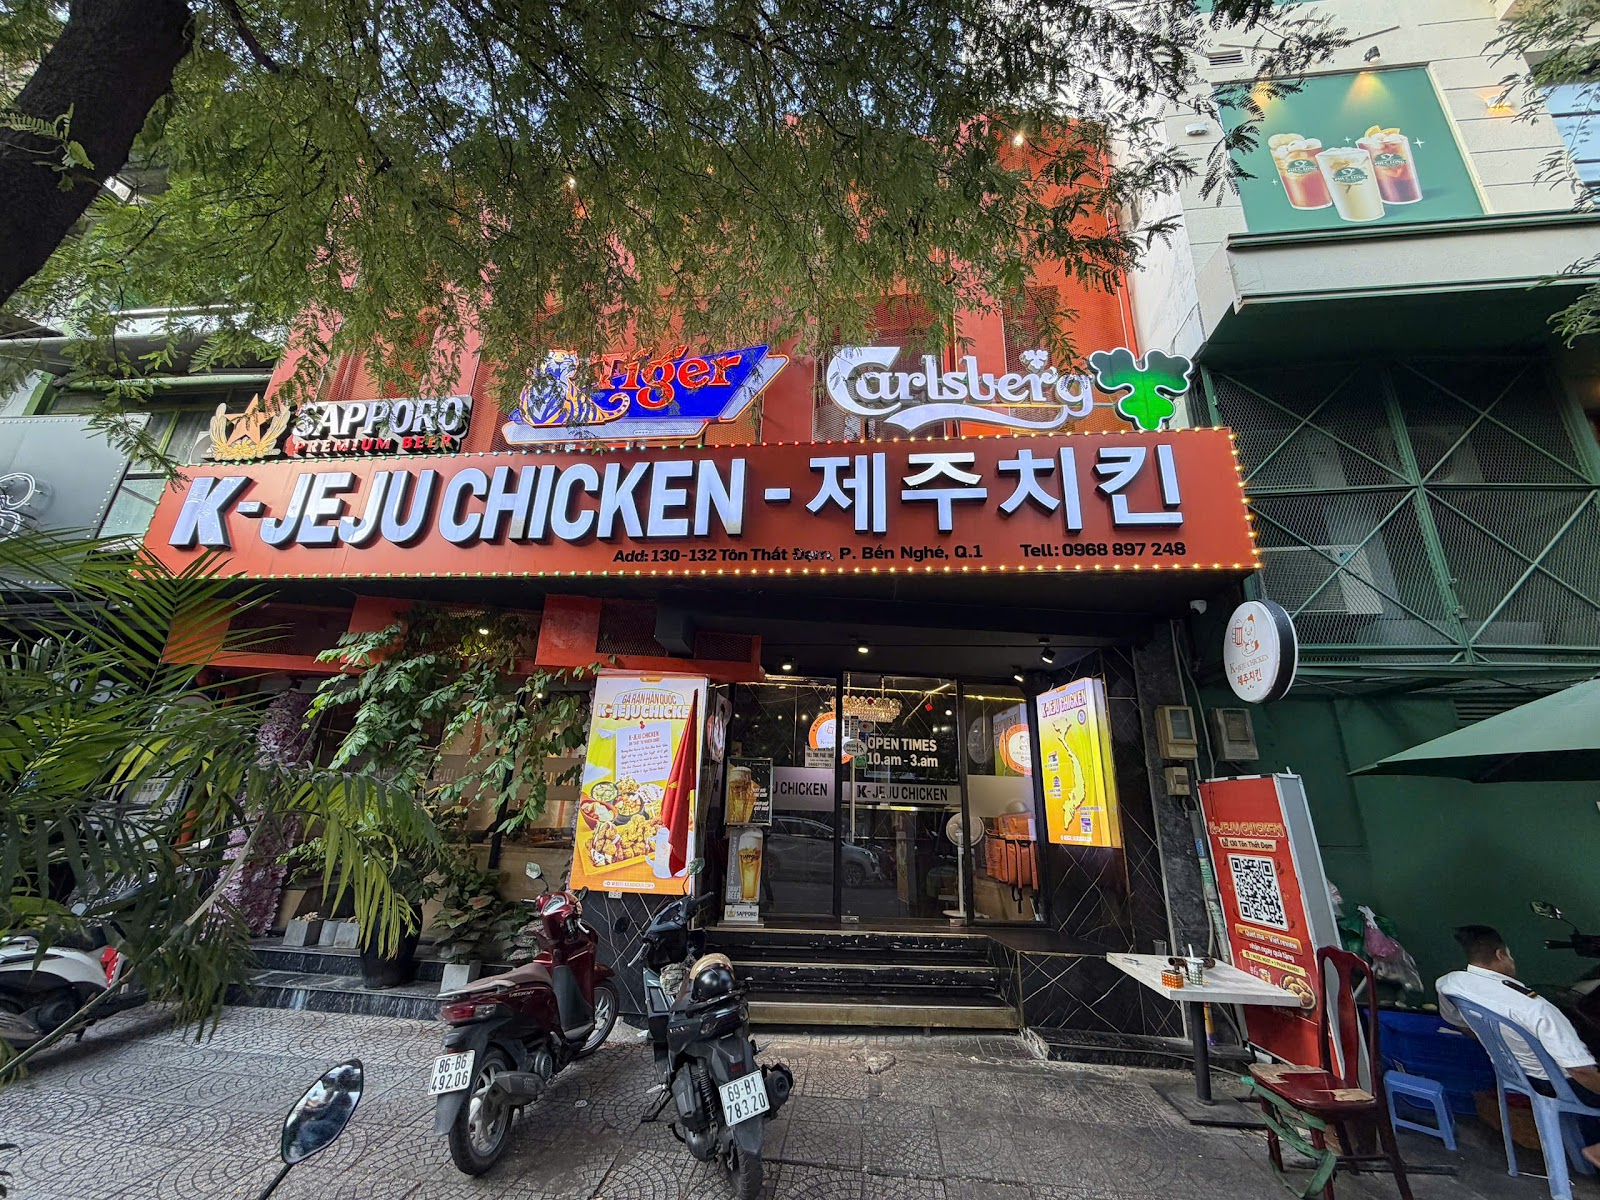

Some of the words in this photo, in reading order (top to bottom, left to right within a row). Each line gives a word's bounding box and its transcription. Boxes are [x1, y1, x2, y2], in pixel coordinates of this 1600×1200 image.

[595, 345, 741, 410] Tiger
[827, 347, 1095, 433] Carlsberg
[292, 397, 464, 437] SAPPORO
[294, 437, 393, 452] PREMIUM
[402, 436, 452, 449] BEER
[169, 469, 440, 549] K-JEJU
[438, 458, 747, 543] CHICKEN
[805, 445, 1185, 534] 제주치킨
[650, 549, 717, 562] 130-132
[719, 548, 748, 561] Tôn
[750, 546, 788, 561] Thất
[839, 547, 857, 560] P.
[900, 545, 949, 562] Nghé,
[954, 544, 983, 559] Q.1
[1020, 543, 1059, 557] Tell:
[1062, 543, 1108, 556] 0968
[1112, 542, 1146, 556] 897
[1150, 541, 1187, 555] 248
[641, 704, 701, 720] CHICKE
[867, 736, 900, 750] OPEN
[901, 738, 938, 752] TIMES
[867, 752, 902, 766] 10.am
[910, 754, 939, 768] 3.am
[780, 781, 828, 796] CHICKEN
[857, 784, 899, 799] K-JEJU
[901, 785, 948, 801] CHICKEN
[439, 1054, 468, 1074] 86-B6
[431, 1070, 469, 1092] 492.06
[727, 1076, 757, 1102] 69-B1
[726, 1092, 766, 1123] 783.20
